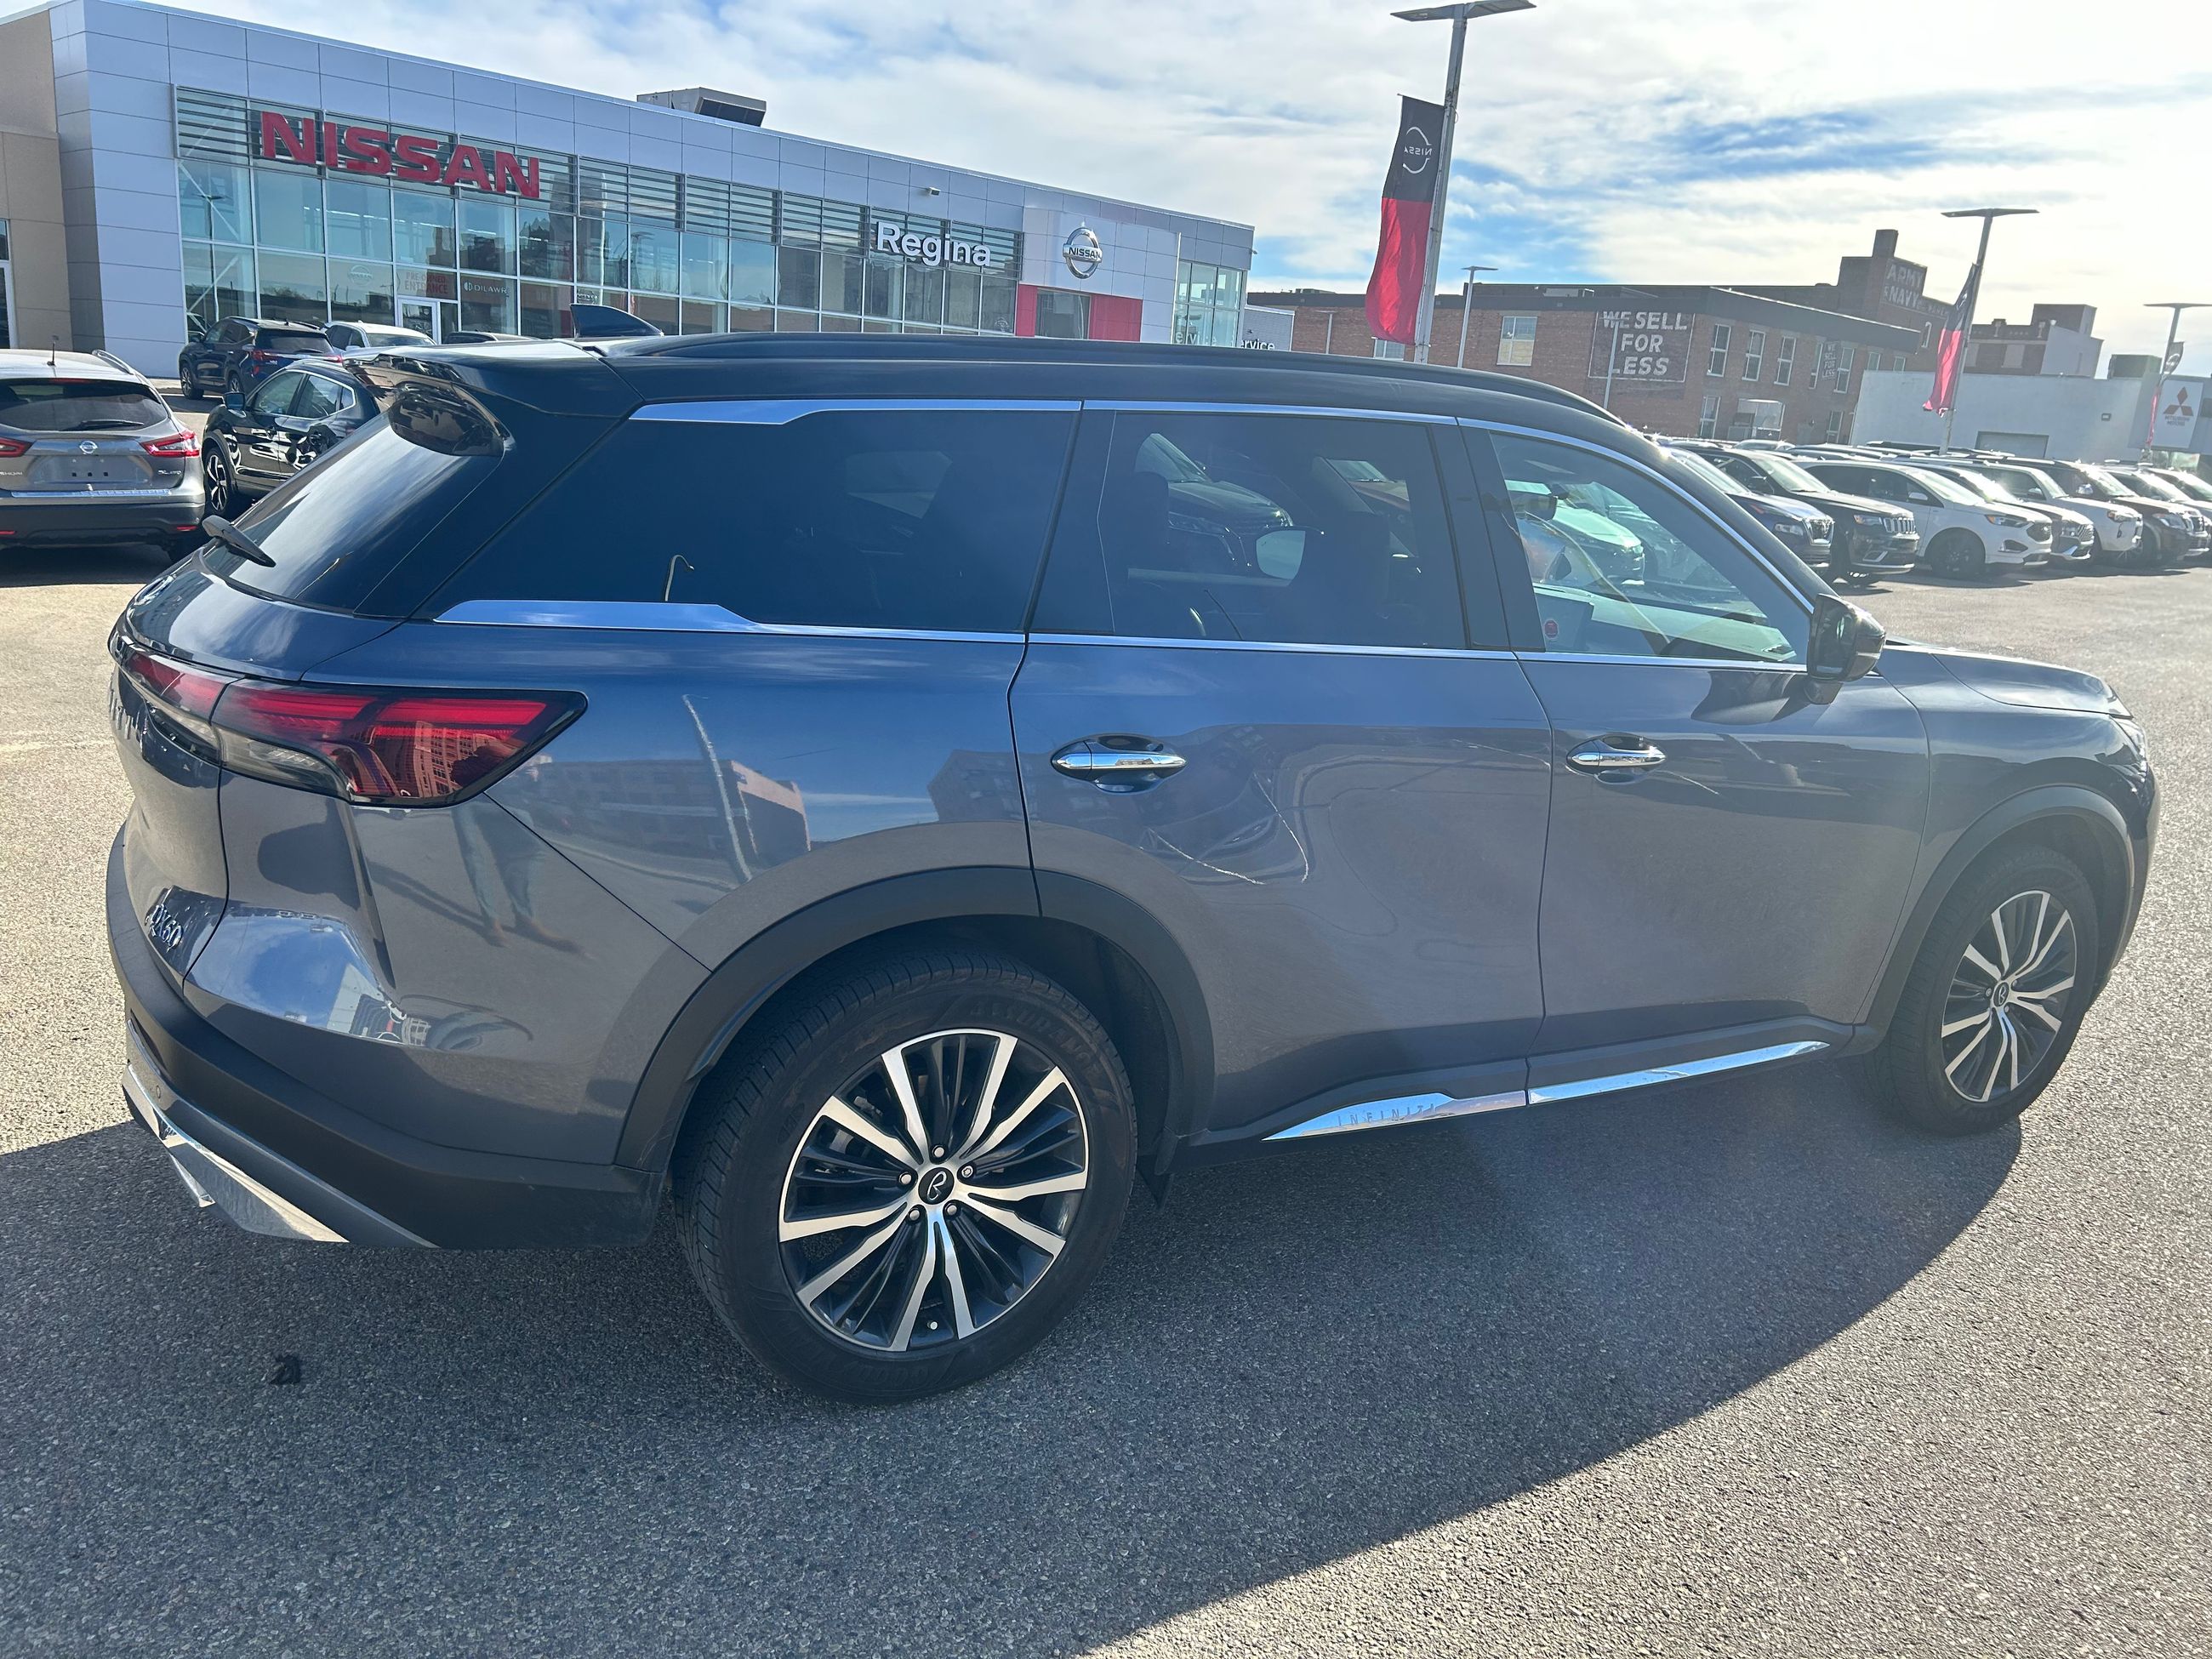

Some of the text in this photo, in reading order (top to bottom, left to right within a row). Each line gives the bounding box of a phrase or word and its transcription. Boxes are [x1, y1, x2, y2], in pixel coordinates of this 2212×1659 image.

[261, 110, 540, 199] NISSAN
[877, 221, 991, 266] Regina
[1069, 247, 1101, 259] NISSAN
[1603, 311, 1687, 330] WE SELL
[1621, 334, 1663, 353] FOR
[150, 904, 182, 949] QX60
[1337, 1103, 1436, 1126] INFINITI
